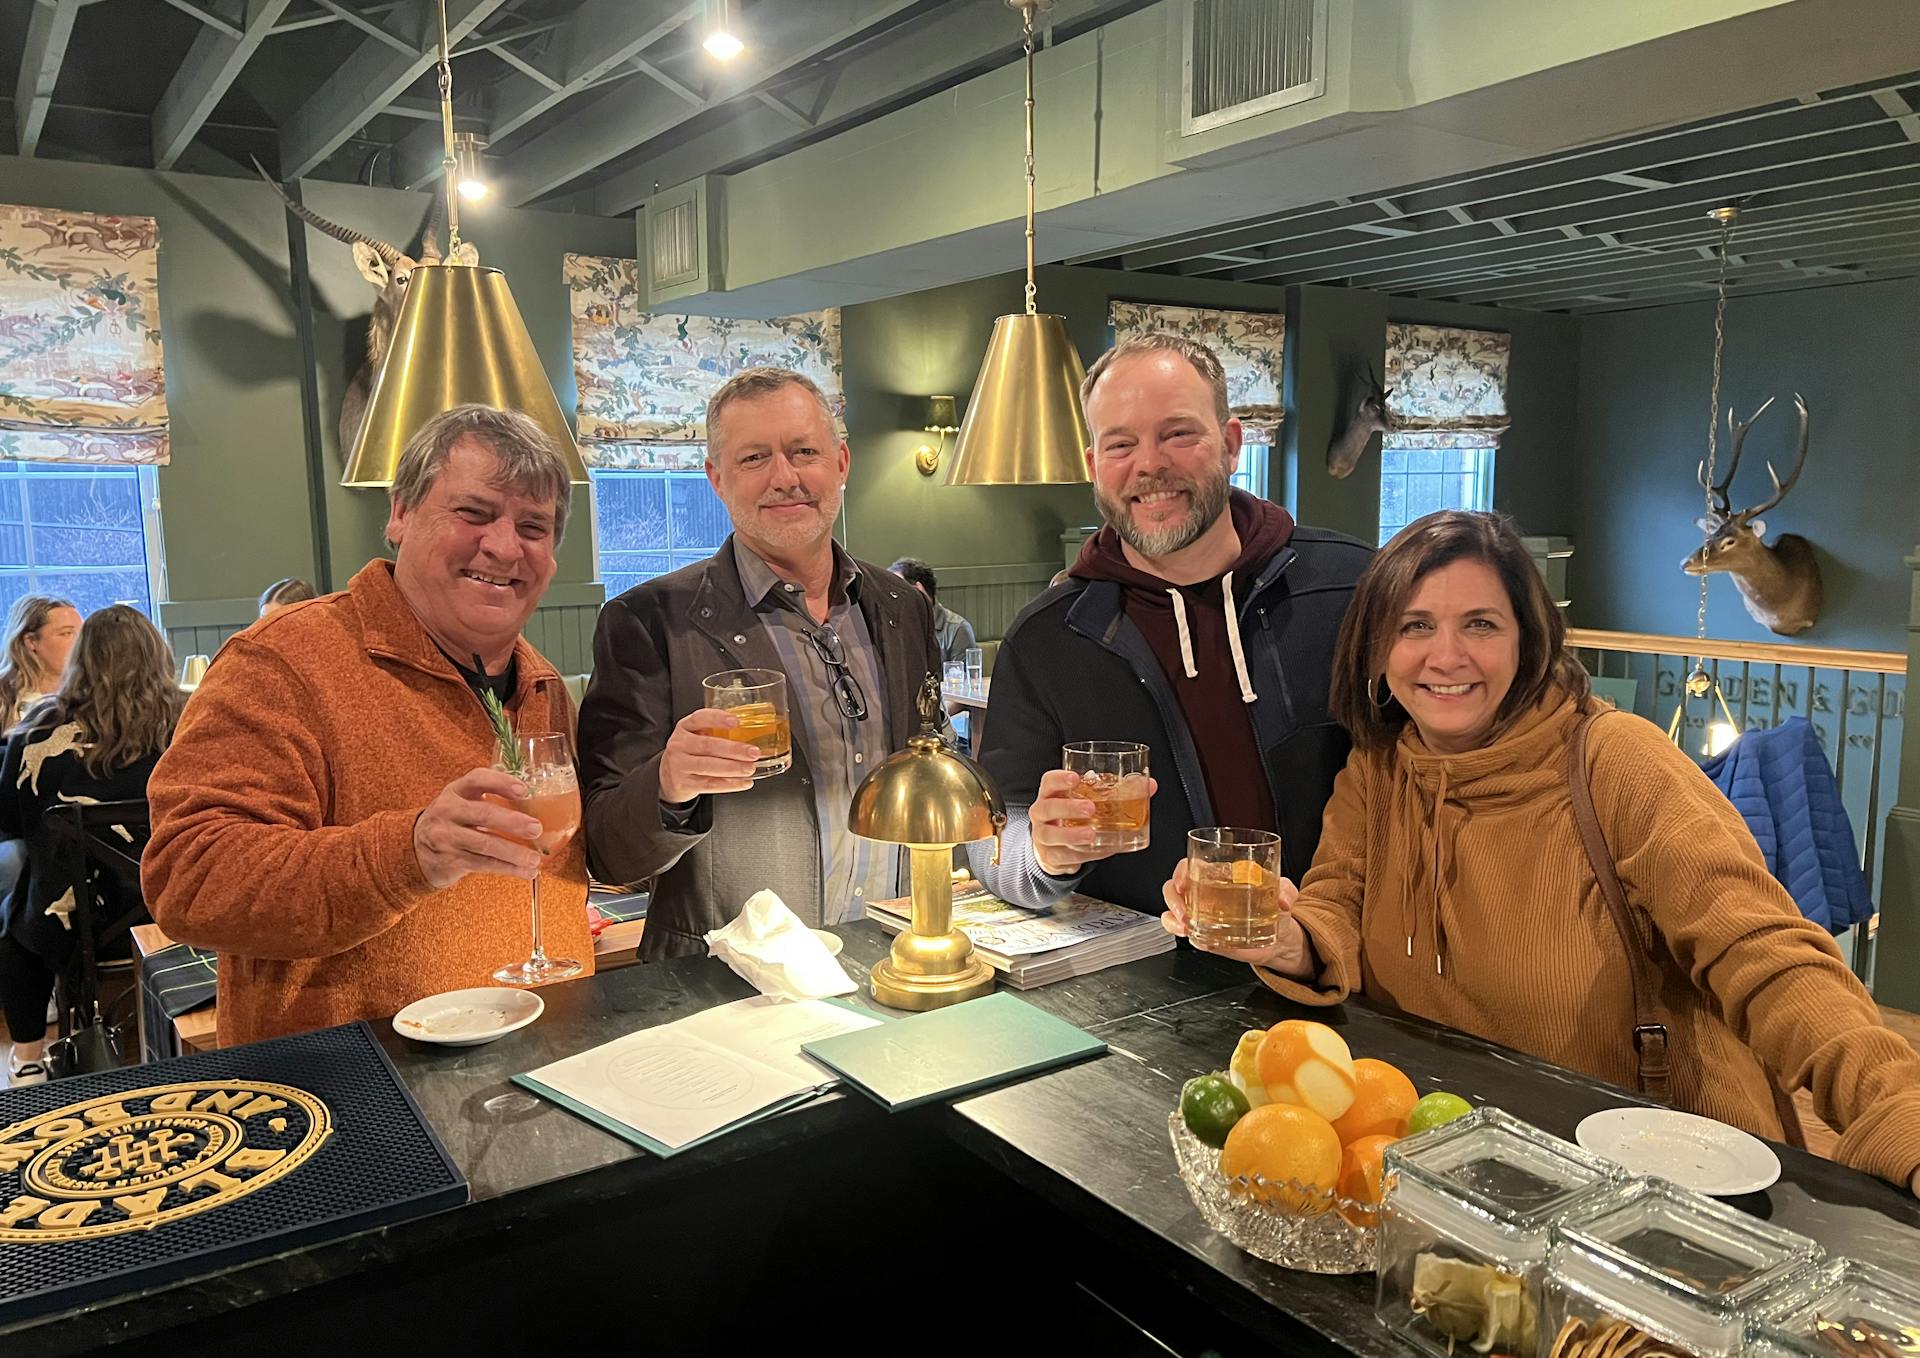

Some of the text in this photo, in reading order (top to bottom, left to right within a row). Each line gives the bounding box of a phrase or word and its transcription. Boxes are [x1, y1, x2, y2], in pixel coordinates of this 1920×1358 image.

[1656, 670, 1909, 720] GDEN & GU
[150, 1090, 287, 1120] AND
[0, 1147, 287, 1229] BLADE
